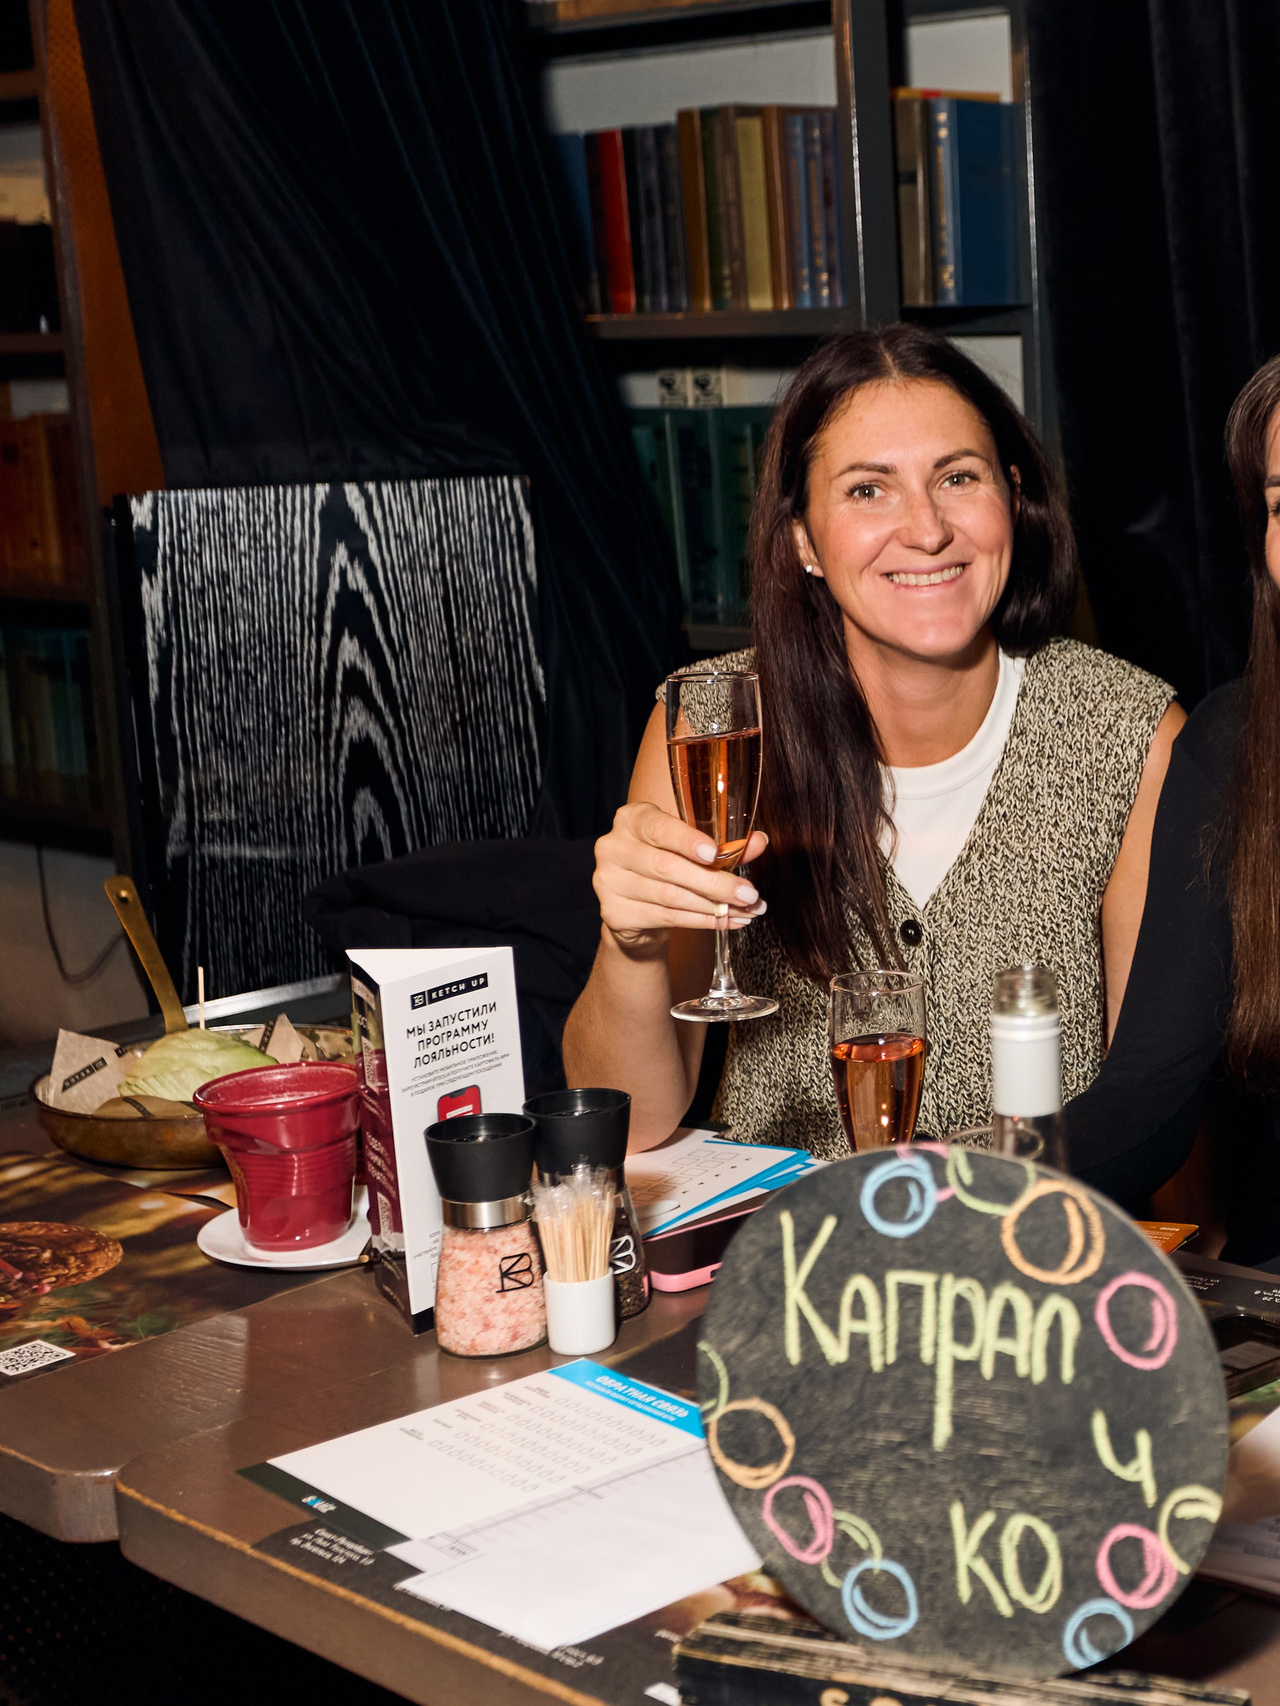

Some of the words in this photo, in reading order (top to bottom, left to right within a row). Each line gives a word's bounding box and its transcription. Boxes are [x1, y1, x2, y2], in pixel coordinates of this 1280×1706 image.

[431, 983, 466, 999] KETCH
[471, 977, 485, 987] UP
[406, 1024, 426, 1039] МЫ
[429, 1001, 497, 1032] ЗАПУСТИЛИ
[418, 1019, 489, 1051] ПРОГРАММУ
[413, 1033, 495, 1069] ЛОЯЛЬНОСТИ!
[595, 1375, 657, 1403] ОБРАТНАЯ
[651, 1399, 690, 1418] СВЯЗЬ
